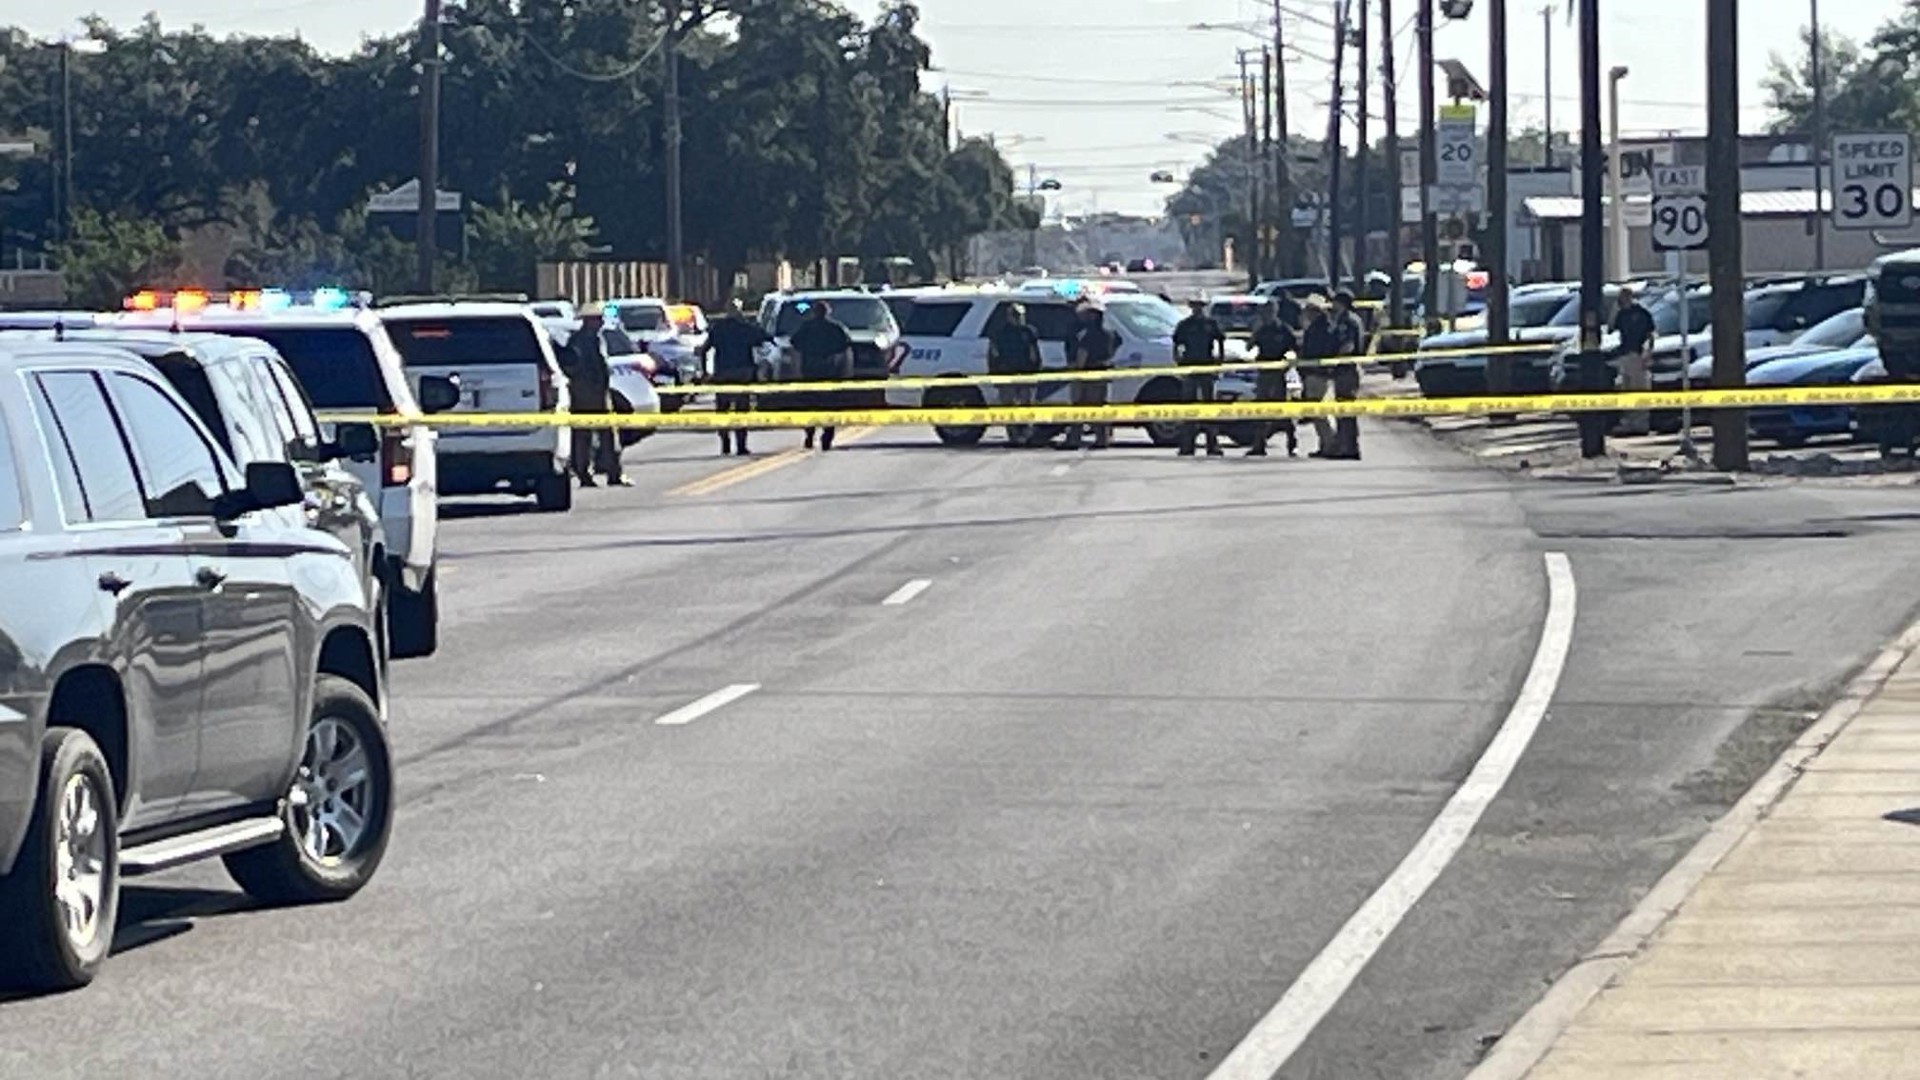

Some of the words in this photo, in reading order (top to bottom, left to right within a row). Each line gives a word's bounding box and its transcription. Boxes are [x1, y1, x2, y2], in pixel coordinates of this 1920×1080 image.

[1441, 143, 1471, 162] 20
[1838, 141, 1904, 158] SPEED
[1658, 169, 1698, 186] EAST
[1844, 163, 1898, 179] LIMIT
[1842, 183, 1904, 219] 30
[1659, 206, 1702, 236] 90
